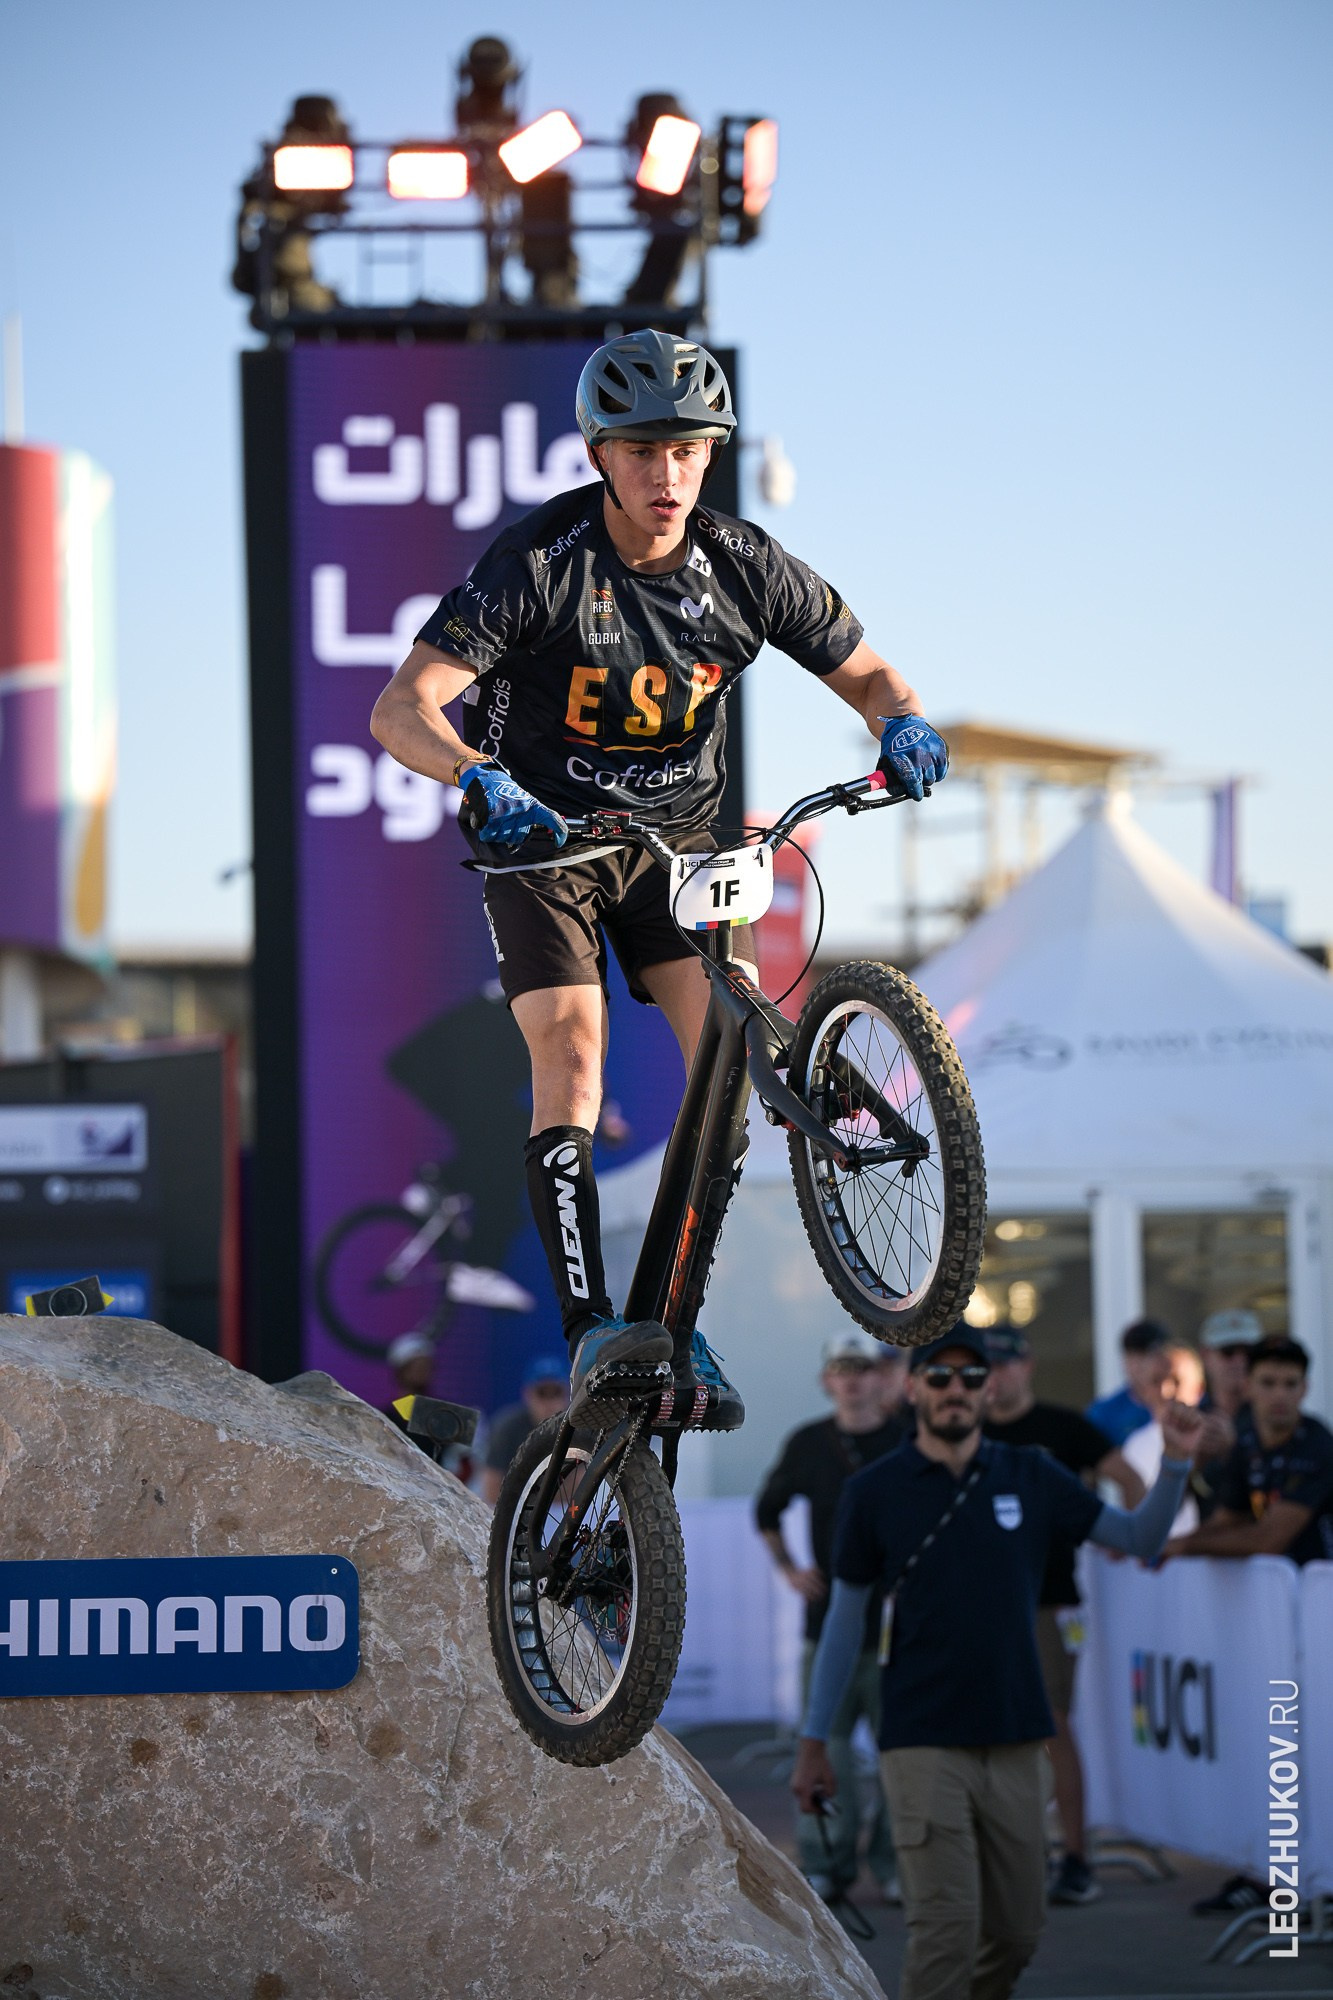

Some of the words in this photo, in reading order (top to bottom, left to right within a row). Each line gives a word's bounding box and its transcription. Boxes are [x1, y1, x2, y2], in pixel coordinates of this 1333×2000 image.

[540, 519, 590, 564] Cofidis
[697, 518, 756, 557] Cofidis
[465, 580, 500, 613] RALI
[592, 600, 613, 614] RFEC
[588, 632, 621, 645] GOBIK
[680, 632, 717, 642] RALI
[479, 677, 512, 759] Cofidis
[566, 755, 693, 791] Cofidis
[710, 879, 740, 908] 1F
[554, 1177, 590, 1300] CLEAN
[1143, 1652, 1217, 1764] UCI
